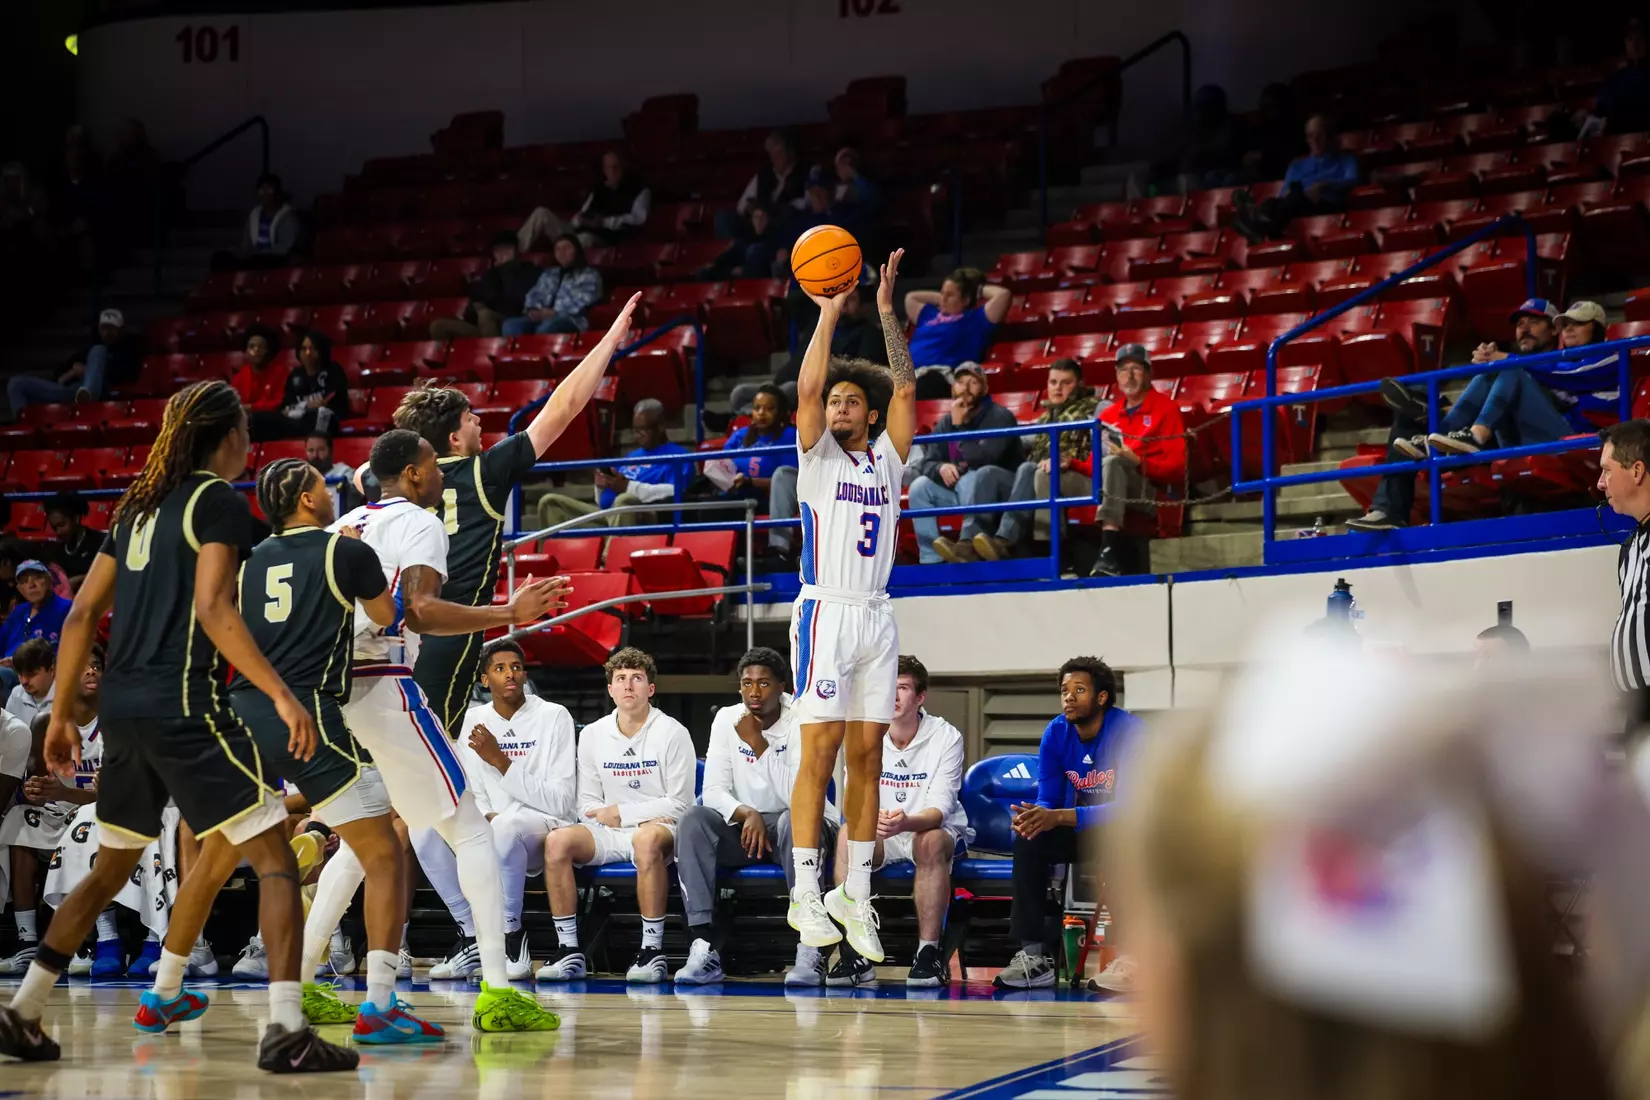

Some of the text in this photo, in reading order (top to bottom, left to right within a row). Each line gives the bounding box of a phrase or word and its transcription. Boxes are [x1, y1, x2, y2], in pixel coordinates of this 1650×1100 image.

[175, 25, 239, 64] 101
[857, 512, 881, 557] 3
[264, 563, 293, 623] 5
[881, 780, 921, 788] BASKETBALL
[71, 821, 92, 843] G
